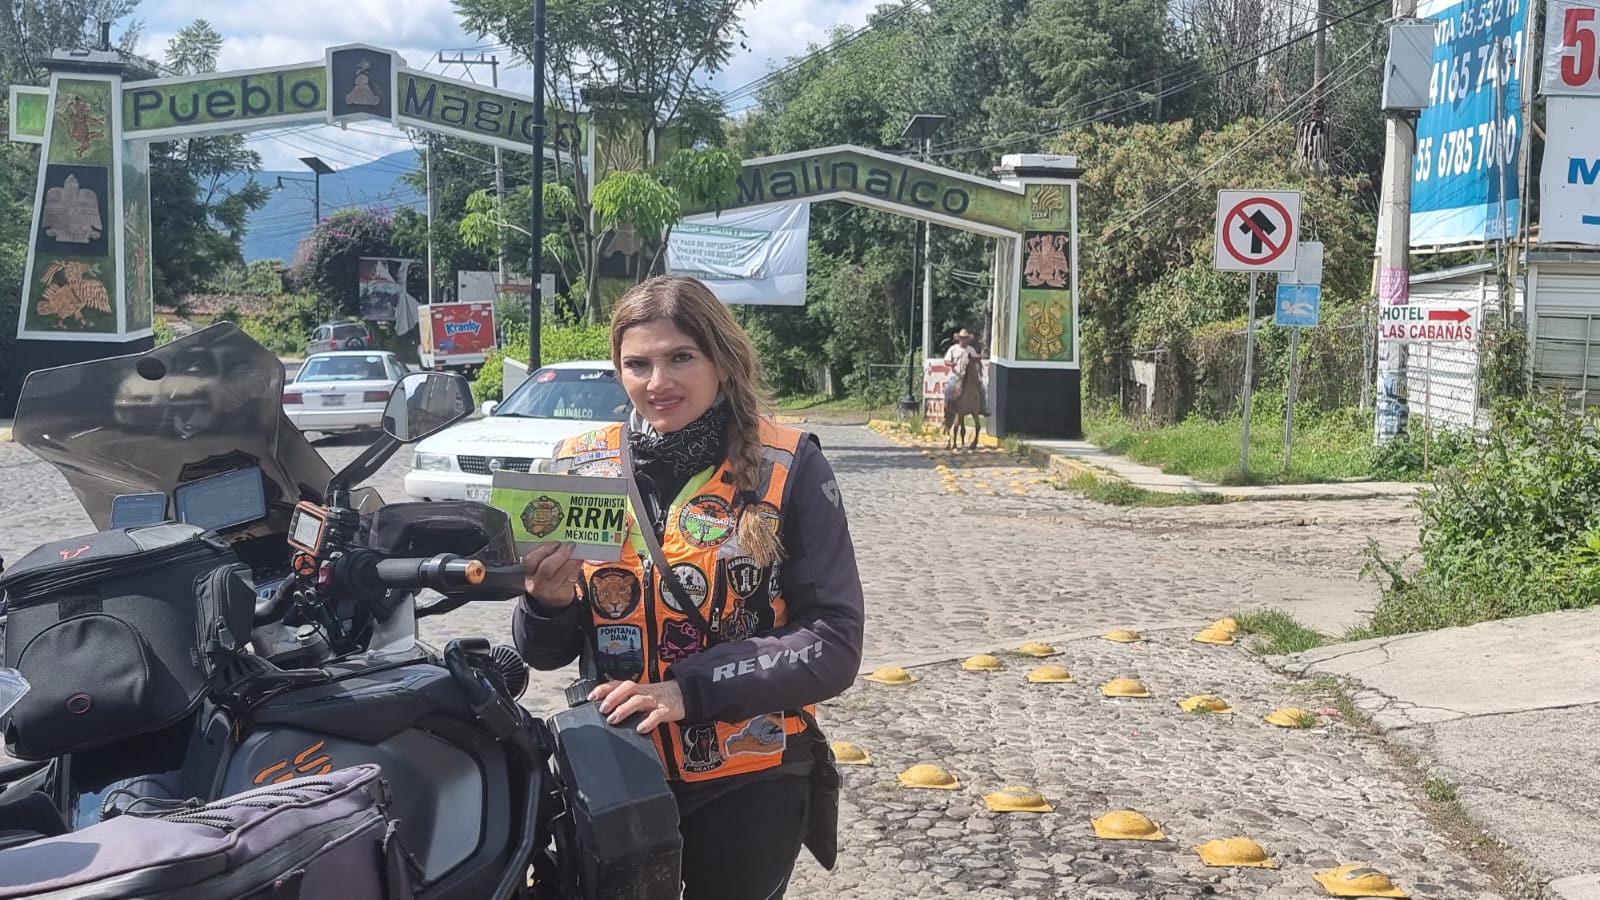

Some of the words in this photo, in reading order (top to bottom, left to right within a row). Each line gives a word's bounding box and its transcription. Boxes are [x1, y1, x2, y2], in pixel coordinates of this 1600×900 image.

[1459, 0, 1501, 38] 35,532
[1560, 8, 1600, 87] 5
[1429, 51, 1471, 106] 4165
[1476, 31, 1522, 93] 7431
[133, 71, 321, 128] Pueblo
[1416, 137, 1433, 182] 55
[1438, 127, 1474, 178] 6785
[736, 159, 970, 215] Malinalco
[1382, 306, 1424, 320] HOTEL
[445, 320, 481, 336] Kranky
[1382, 324, 1405, 338] LAS
[1410, 322, 1472, 340] CABAÑAS
[571, 495, 625, 508] MOTOTURISTA
[566, 506, 624, 531] RRM
[565, 528, 599, 541] MÉXICO
[600, 627, 637, 636] FONTANA
[693, 764, 716, 772] DEATH
